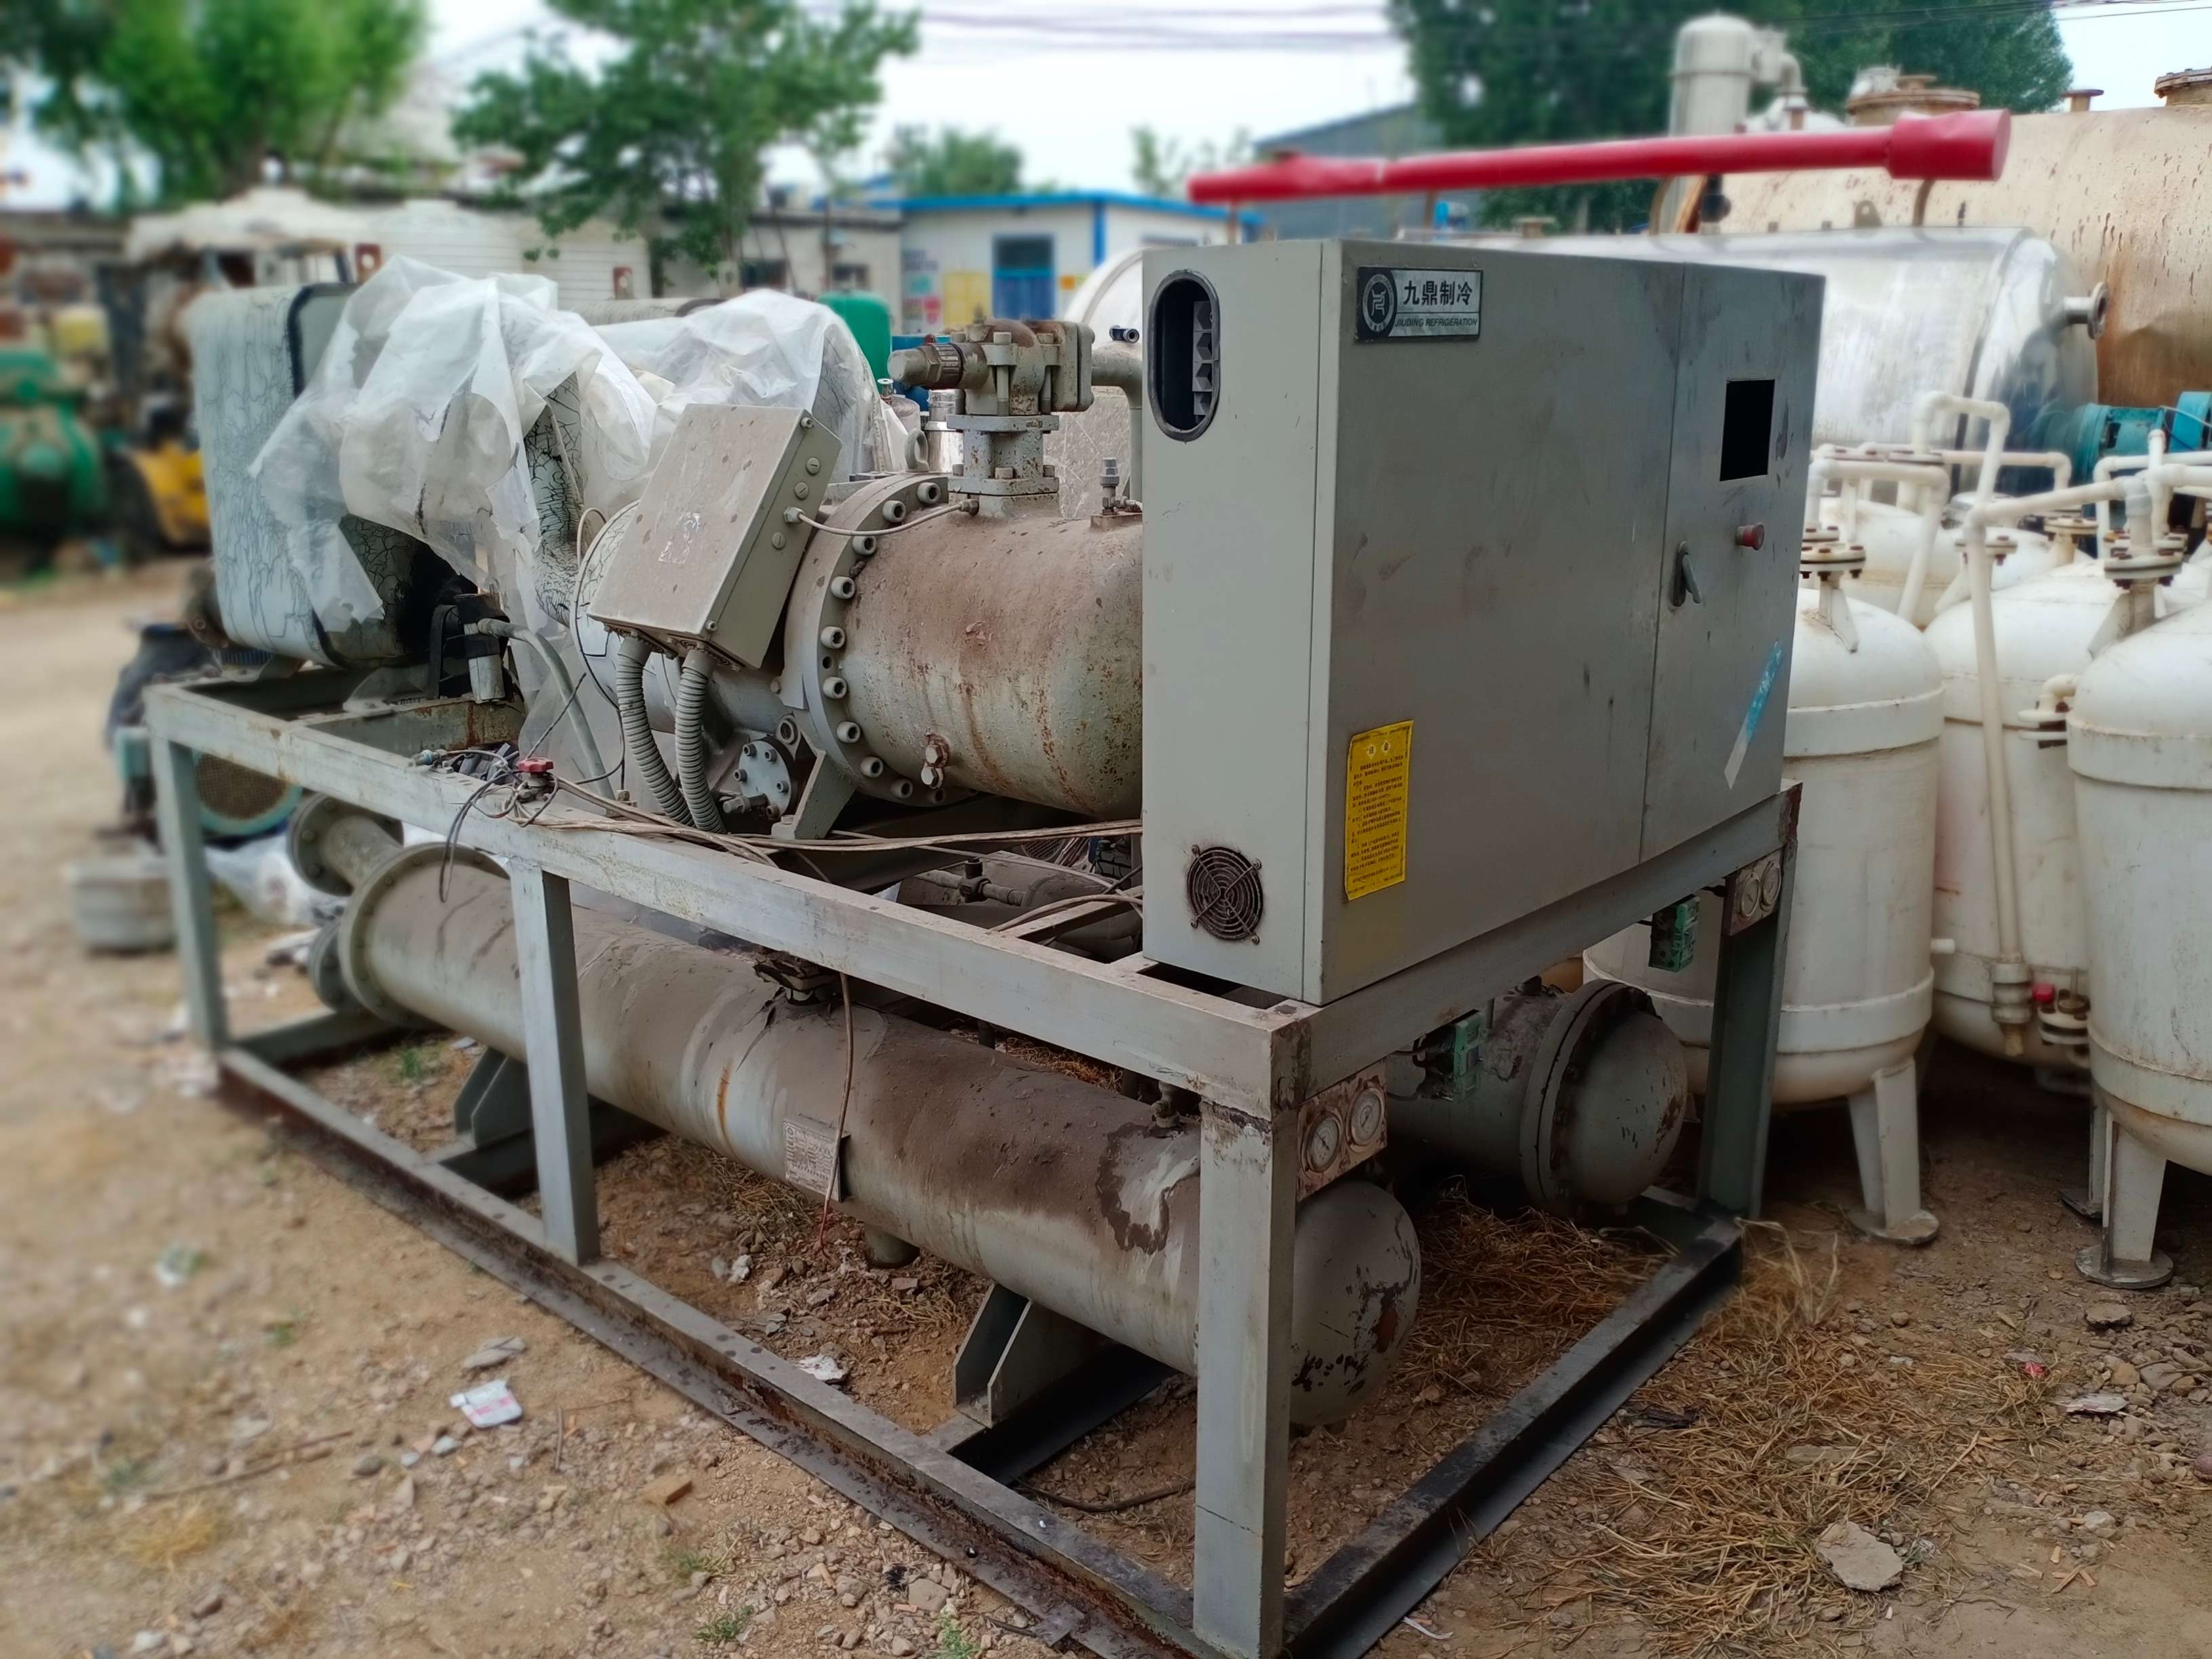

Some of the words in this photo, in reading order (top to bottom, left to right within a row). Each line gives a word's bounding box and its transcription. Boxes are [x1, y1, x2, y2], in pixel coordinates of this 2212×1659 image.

[1404, 280, 1473, 306] 九鼎制冷
[1395, 319, 1424, 327] JIUDING
[1426, 318, 1477, 326] REFRIGERATION
